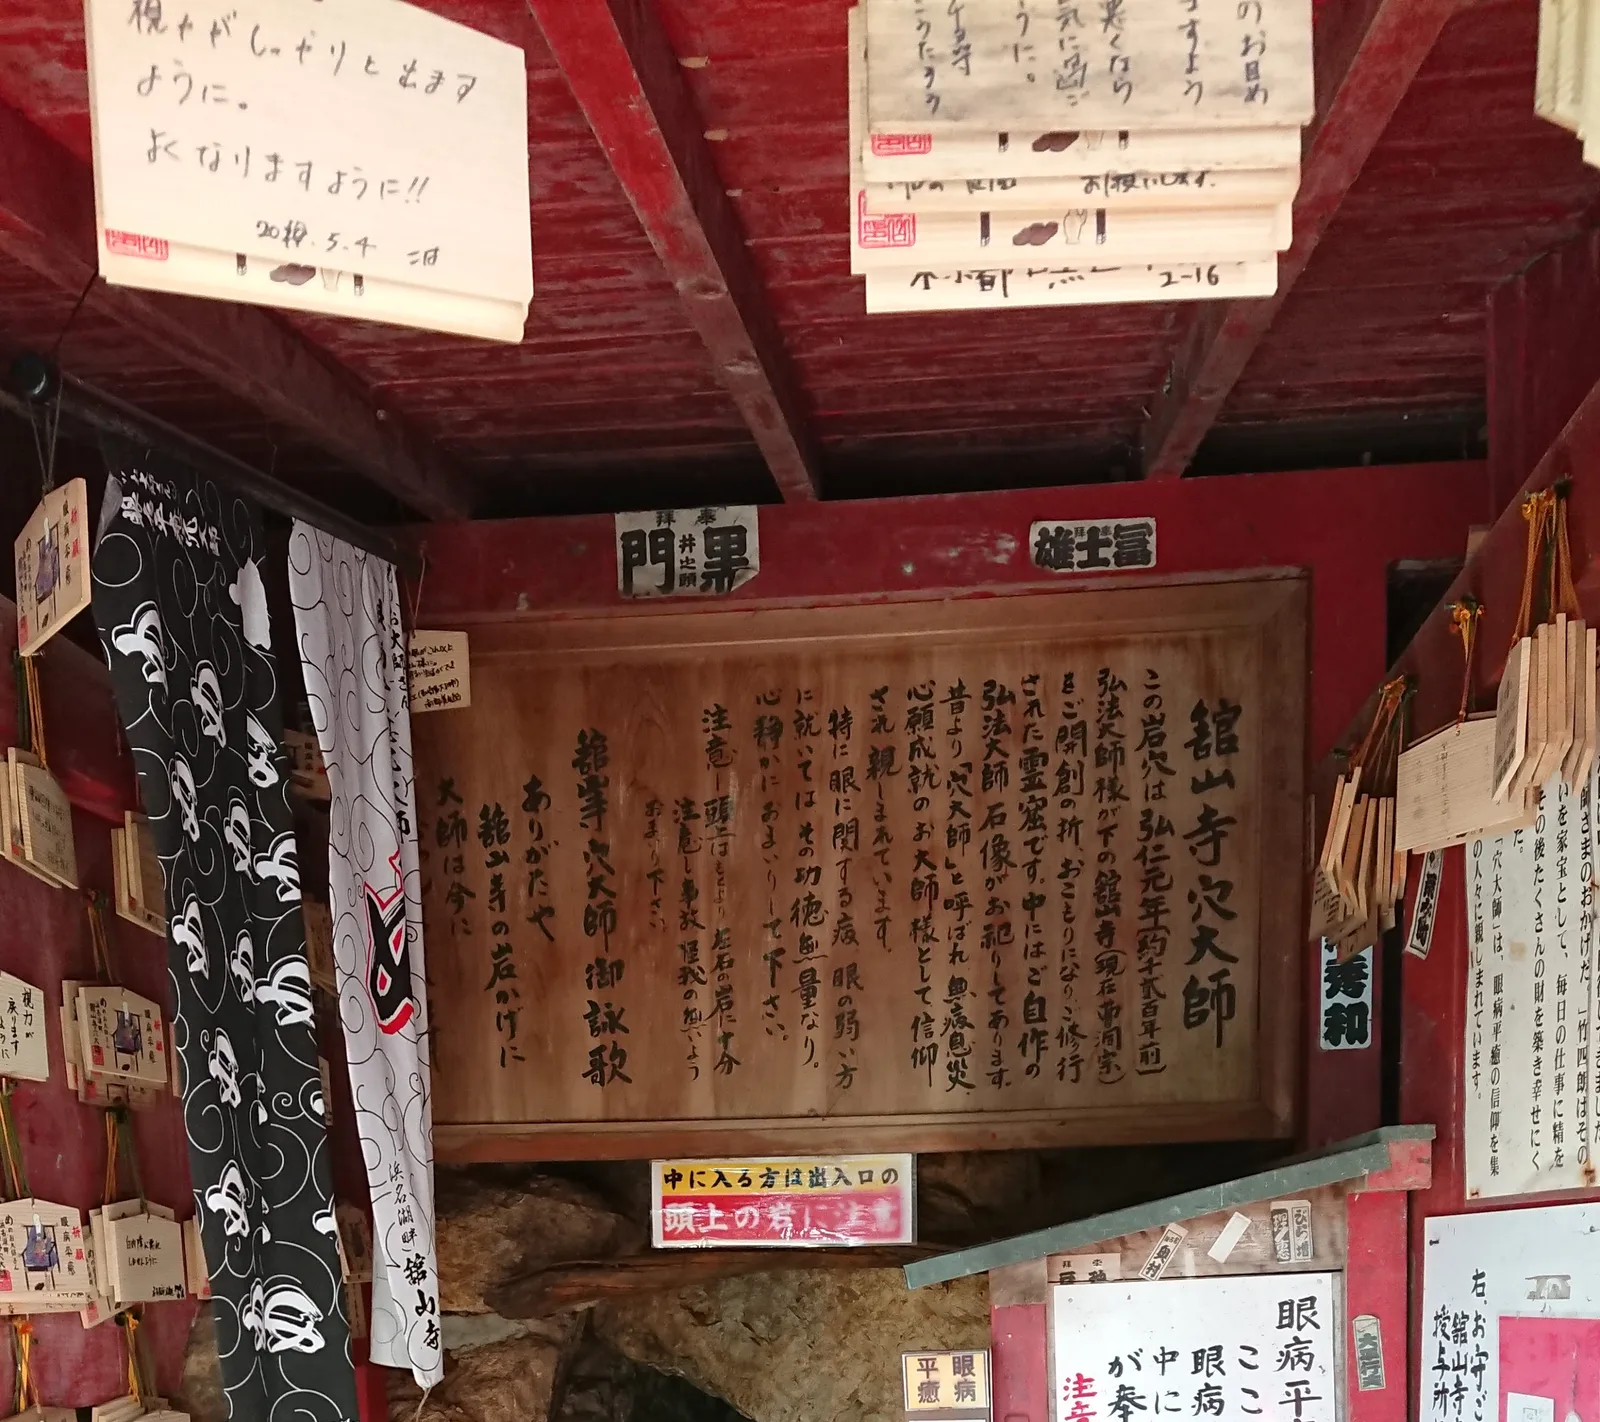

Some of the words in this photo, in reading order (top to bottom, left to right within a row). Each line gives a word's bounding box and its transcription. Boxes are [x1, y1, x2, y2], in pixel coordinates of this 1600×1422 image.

[521, 773, 560, 942] ありがたや
[1324, 937, 1369, 1047] 秀和
[388, 1161, 418, 1250] 浜名湖畔
[663, 1166, 900, 1191] 中に入る方は出入口の
[916, 1356, 940, 1403] 平癒
[951, 1355, 977, 1402] 眼病
